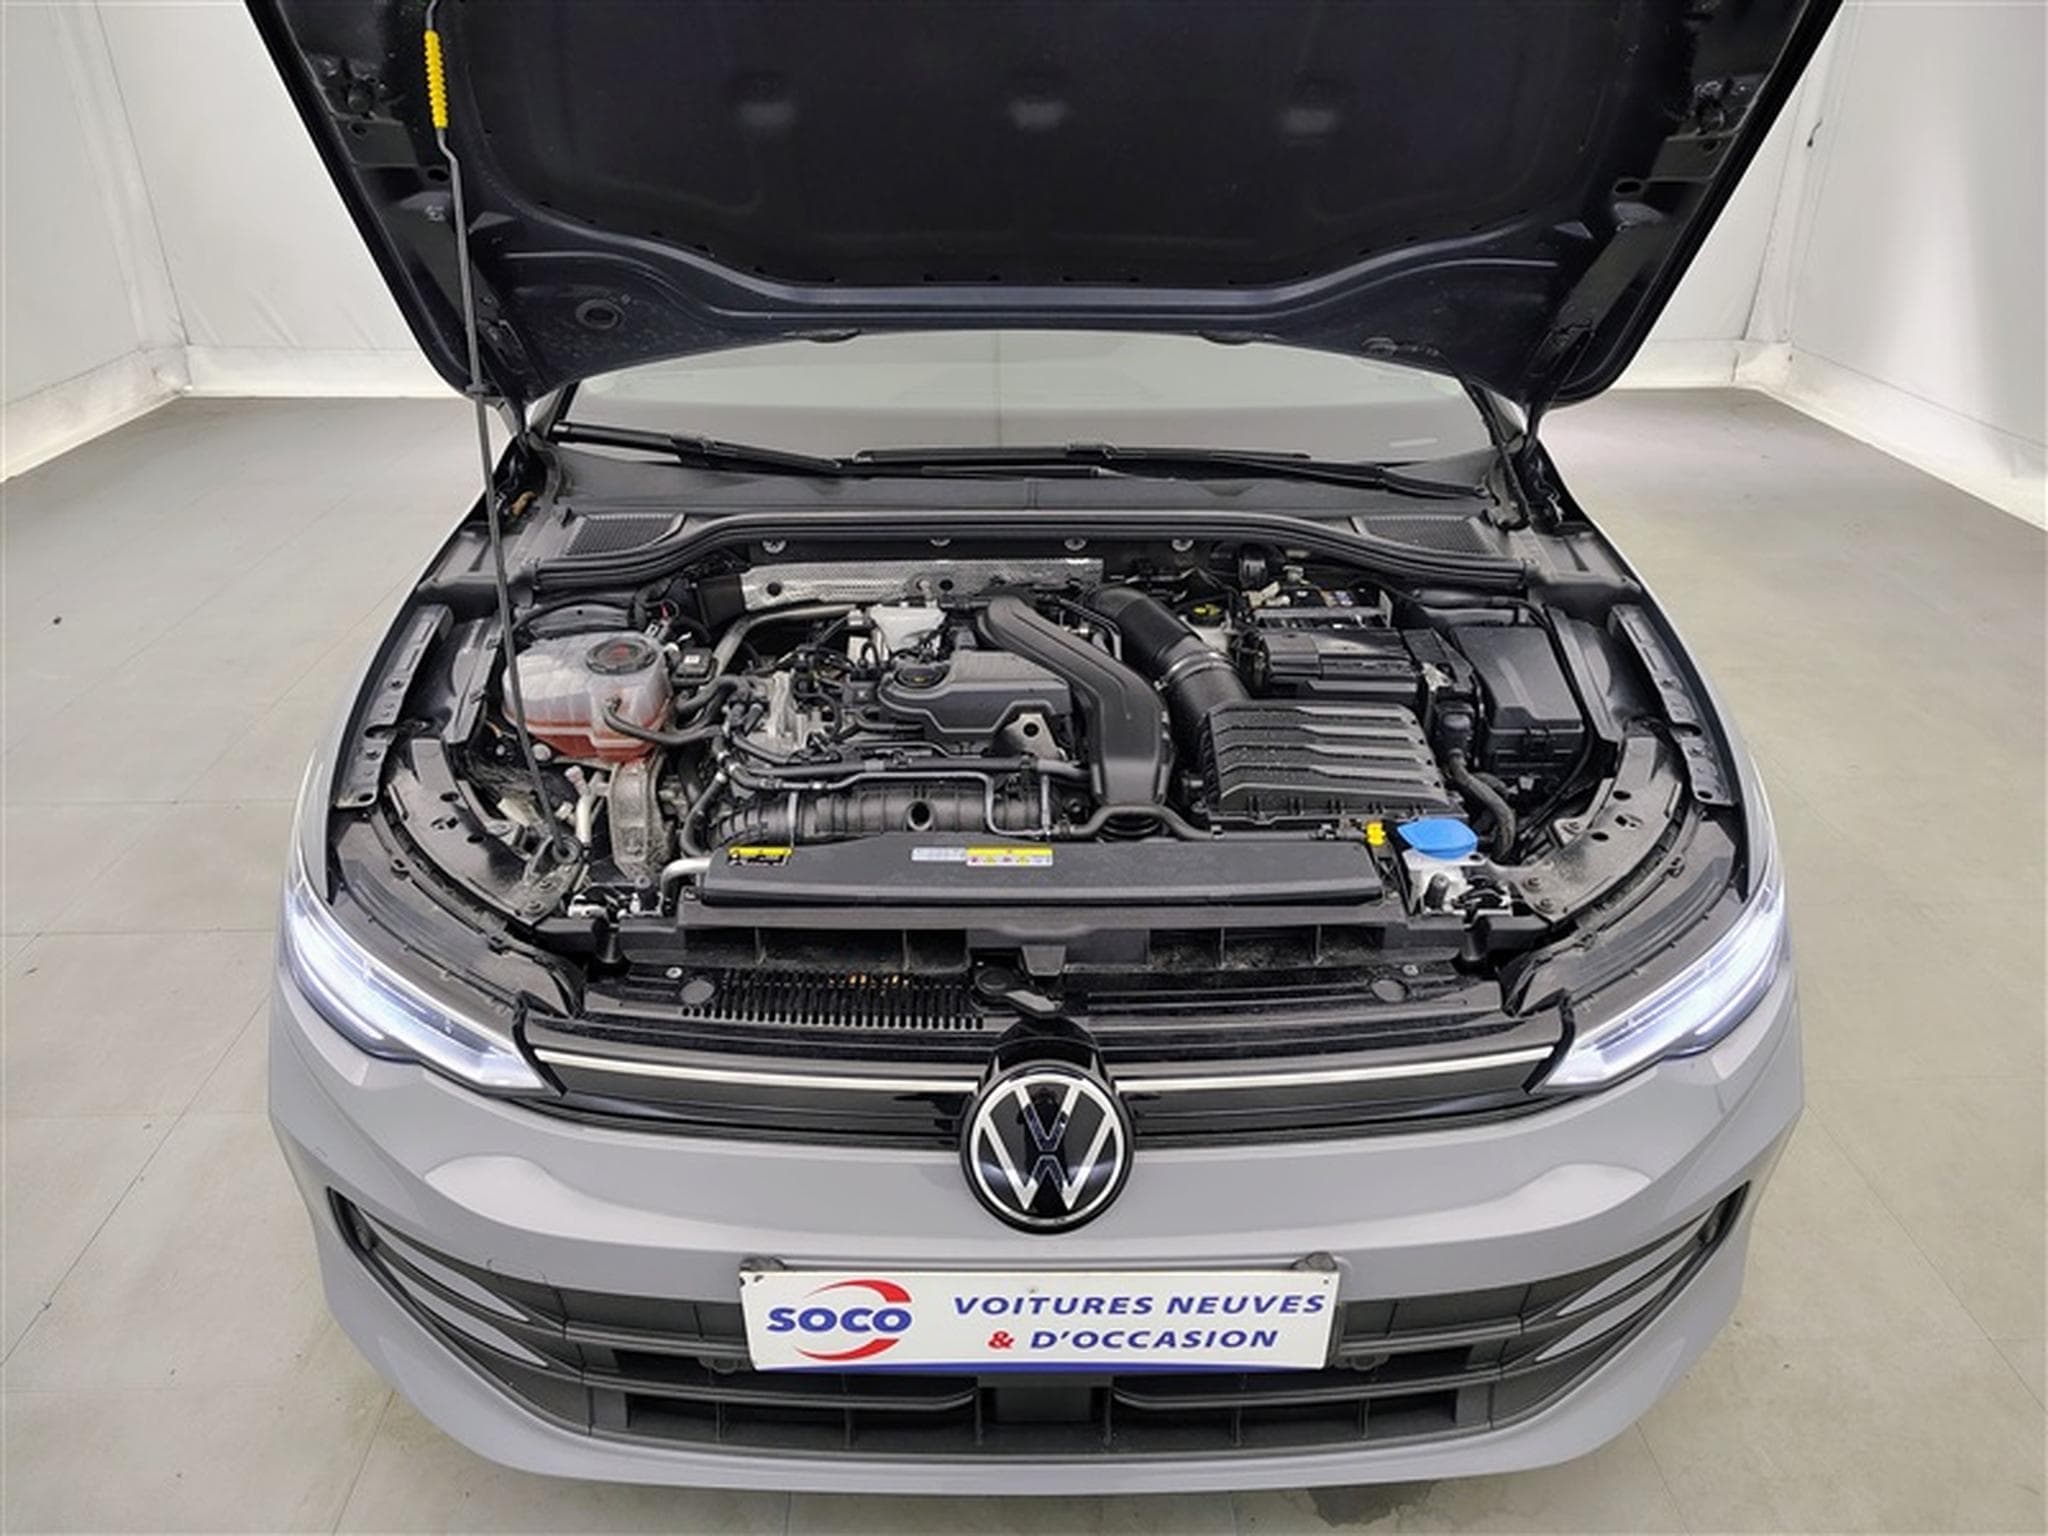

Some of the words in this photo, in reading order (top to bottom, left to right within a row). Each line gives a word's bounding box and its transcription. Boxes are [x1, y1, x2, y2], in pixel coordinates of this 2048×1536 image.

[954, 1296, 1153, 1316] VOITURES
[1166, 1294, 1326, 1315] NEUVES
[766, 1307, 913, 1333] SOCO
[987, 1330, 1015, 1350] &
[1030, 1329, 1278, 1350] D'OCCASION
